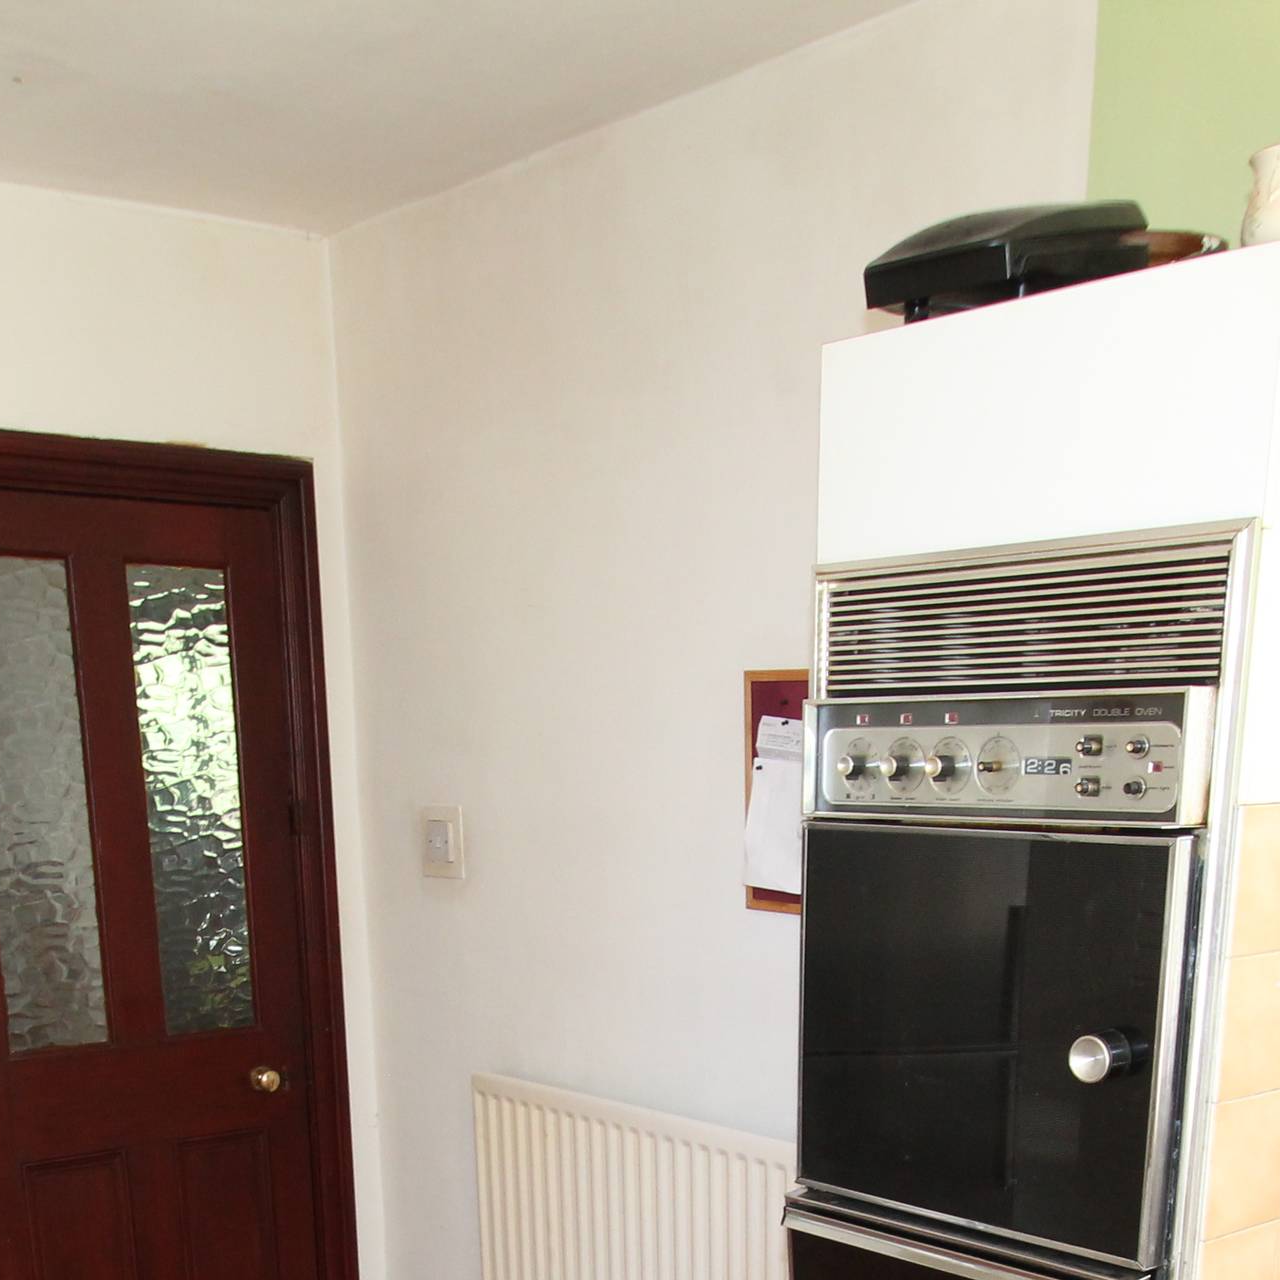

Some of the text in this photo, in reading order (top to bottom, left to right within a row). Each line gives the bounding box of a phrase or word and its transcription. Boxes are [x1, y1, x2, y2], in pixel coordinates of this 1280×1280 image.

[1049, 707, 1163, 717] TRICITY DOUBLE OVEN
